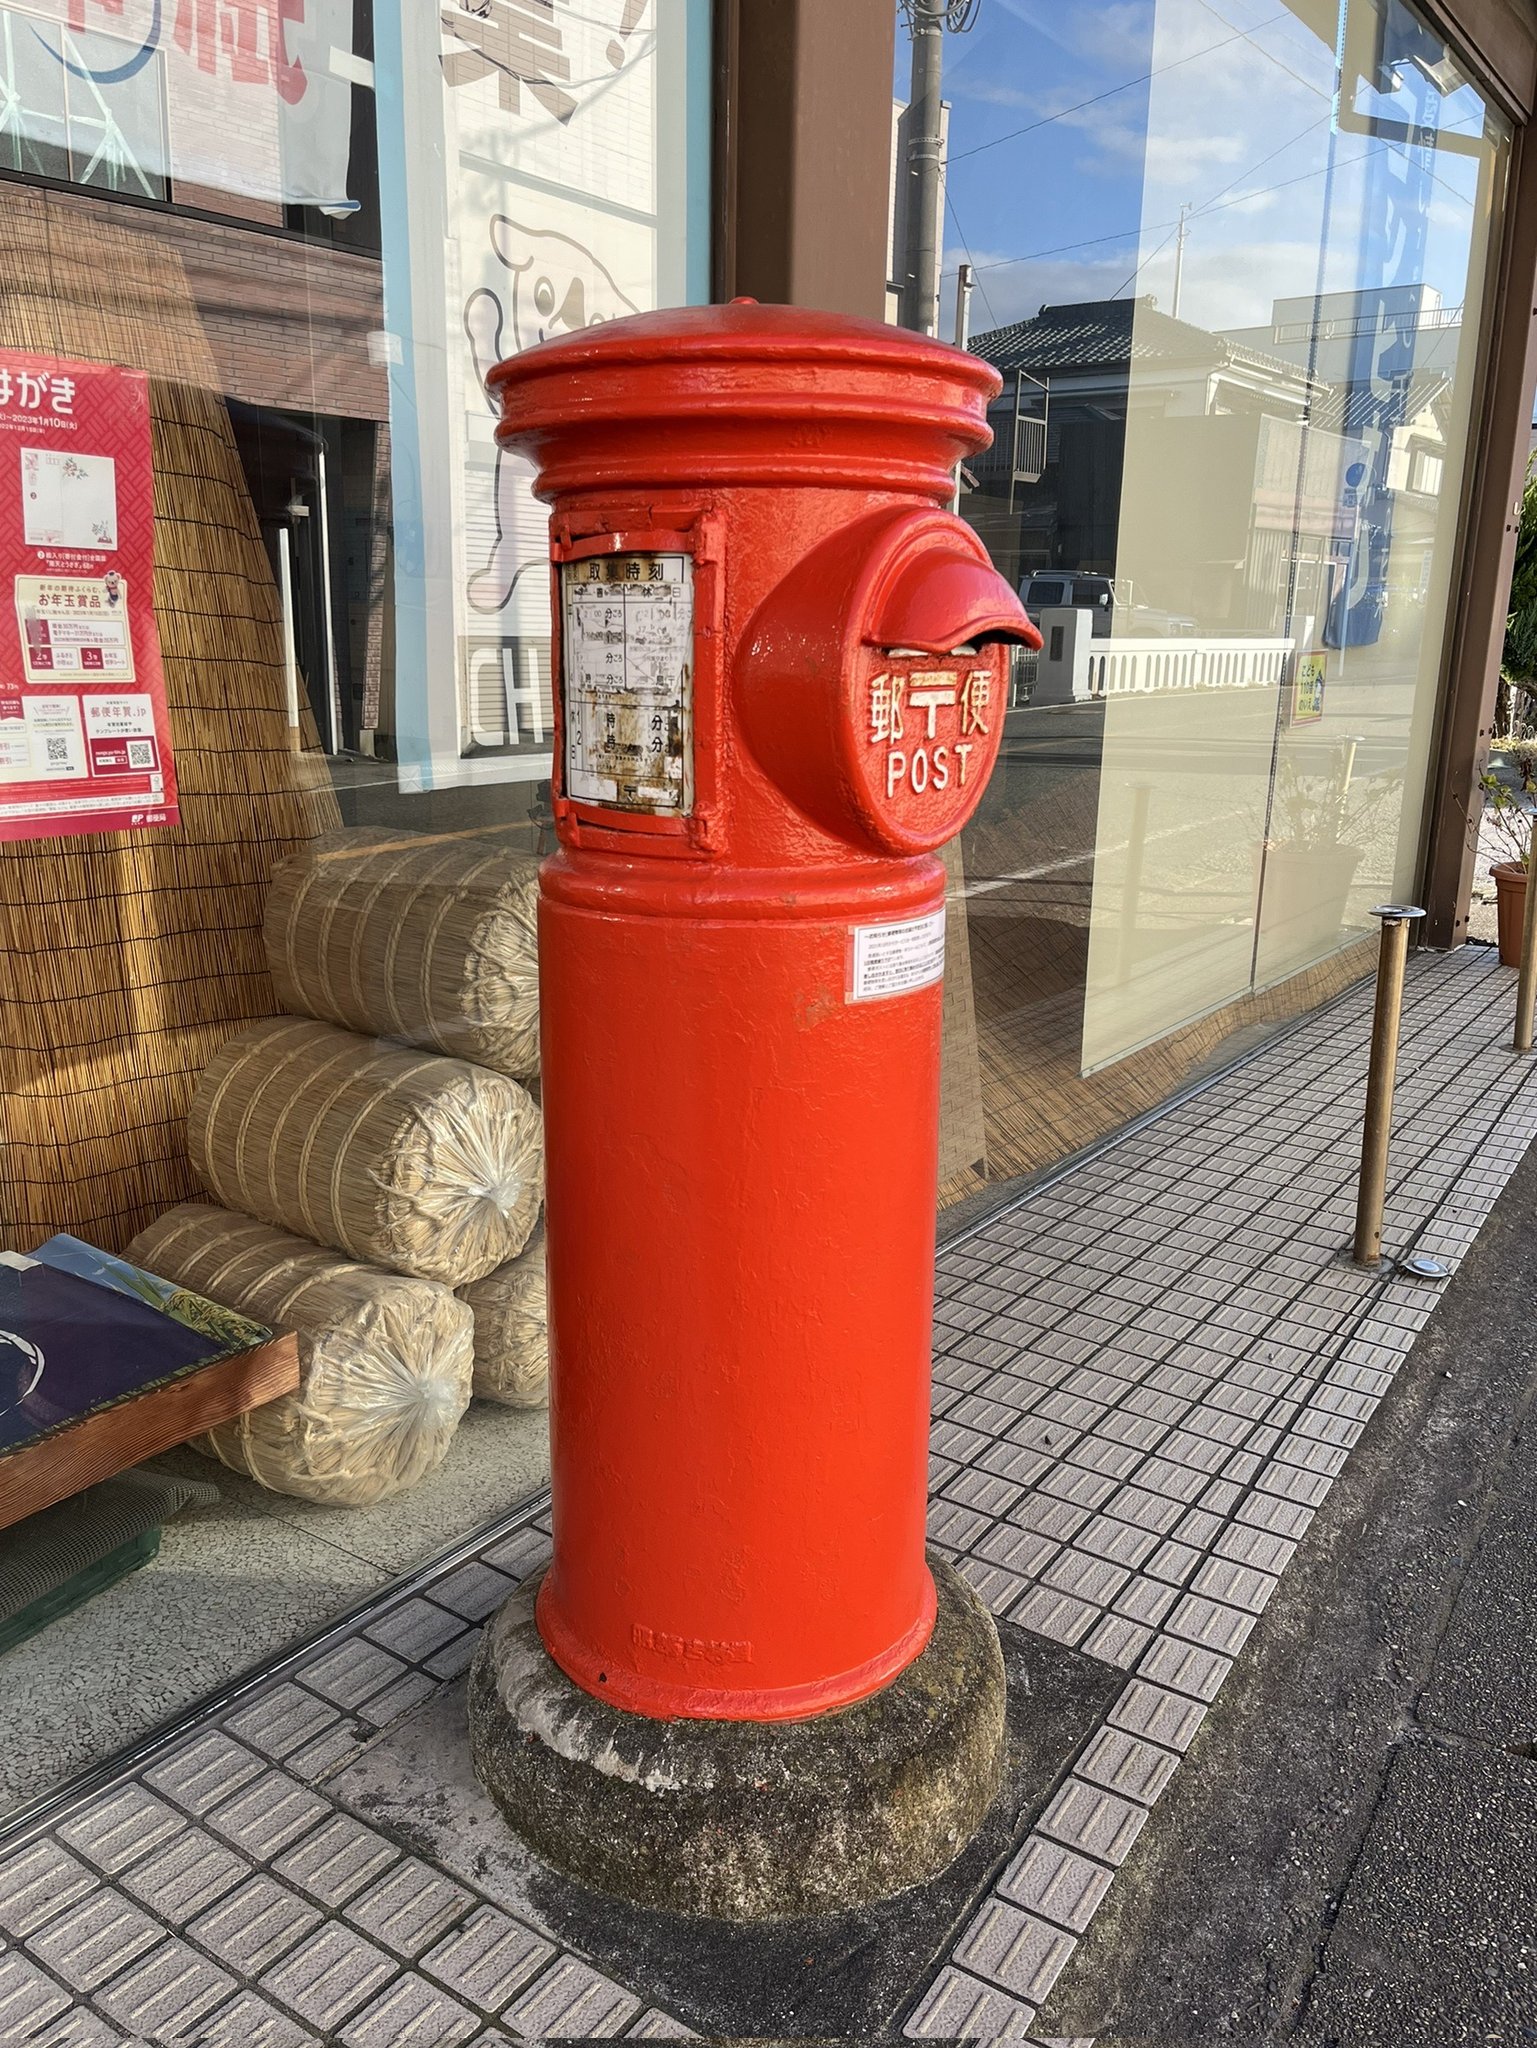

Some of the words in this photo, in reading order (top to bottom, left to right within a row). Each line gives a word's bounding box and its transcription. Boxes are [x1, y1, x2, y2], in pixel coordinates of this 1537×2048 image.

[39, 594, 101, 608] お年玉賞品
[90, 706, 147, 718] 郵便年賀.jp
[887, 744, 974, 798] POST
